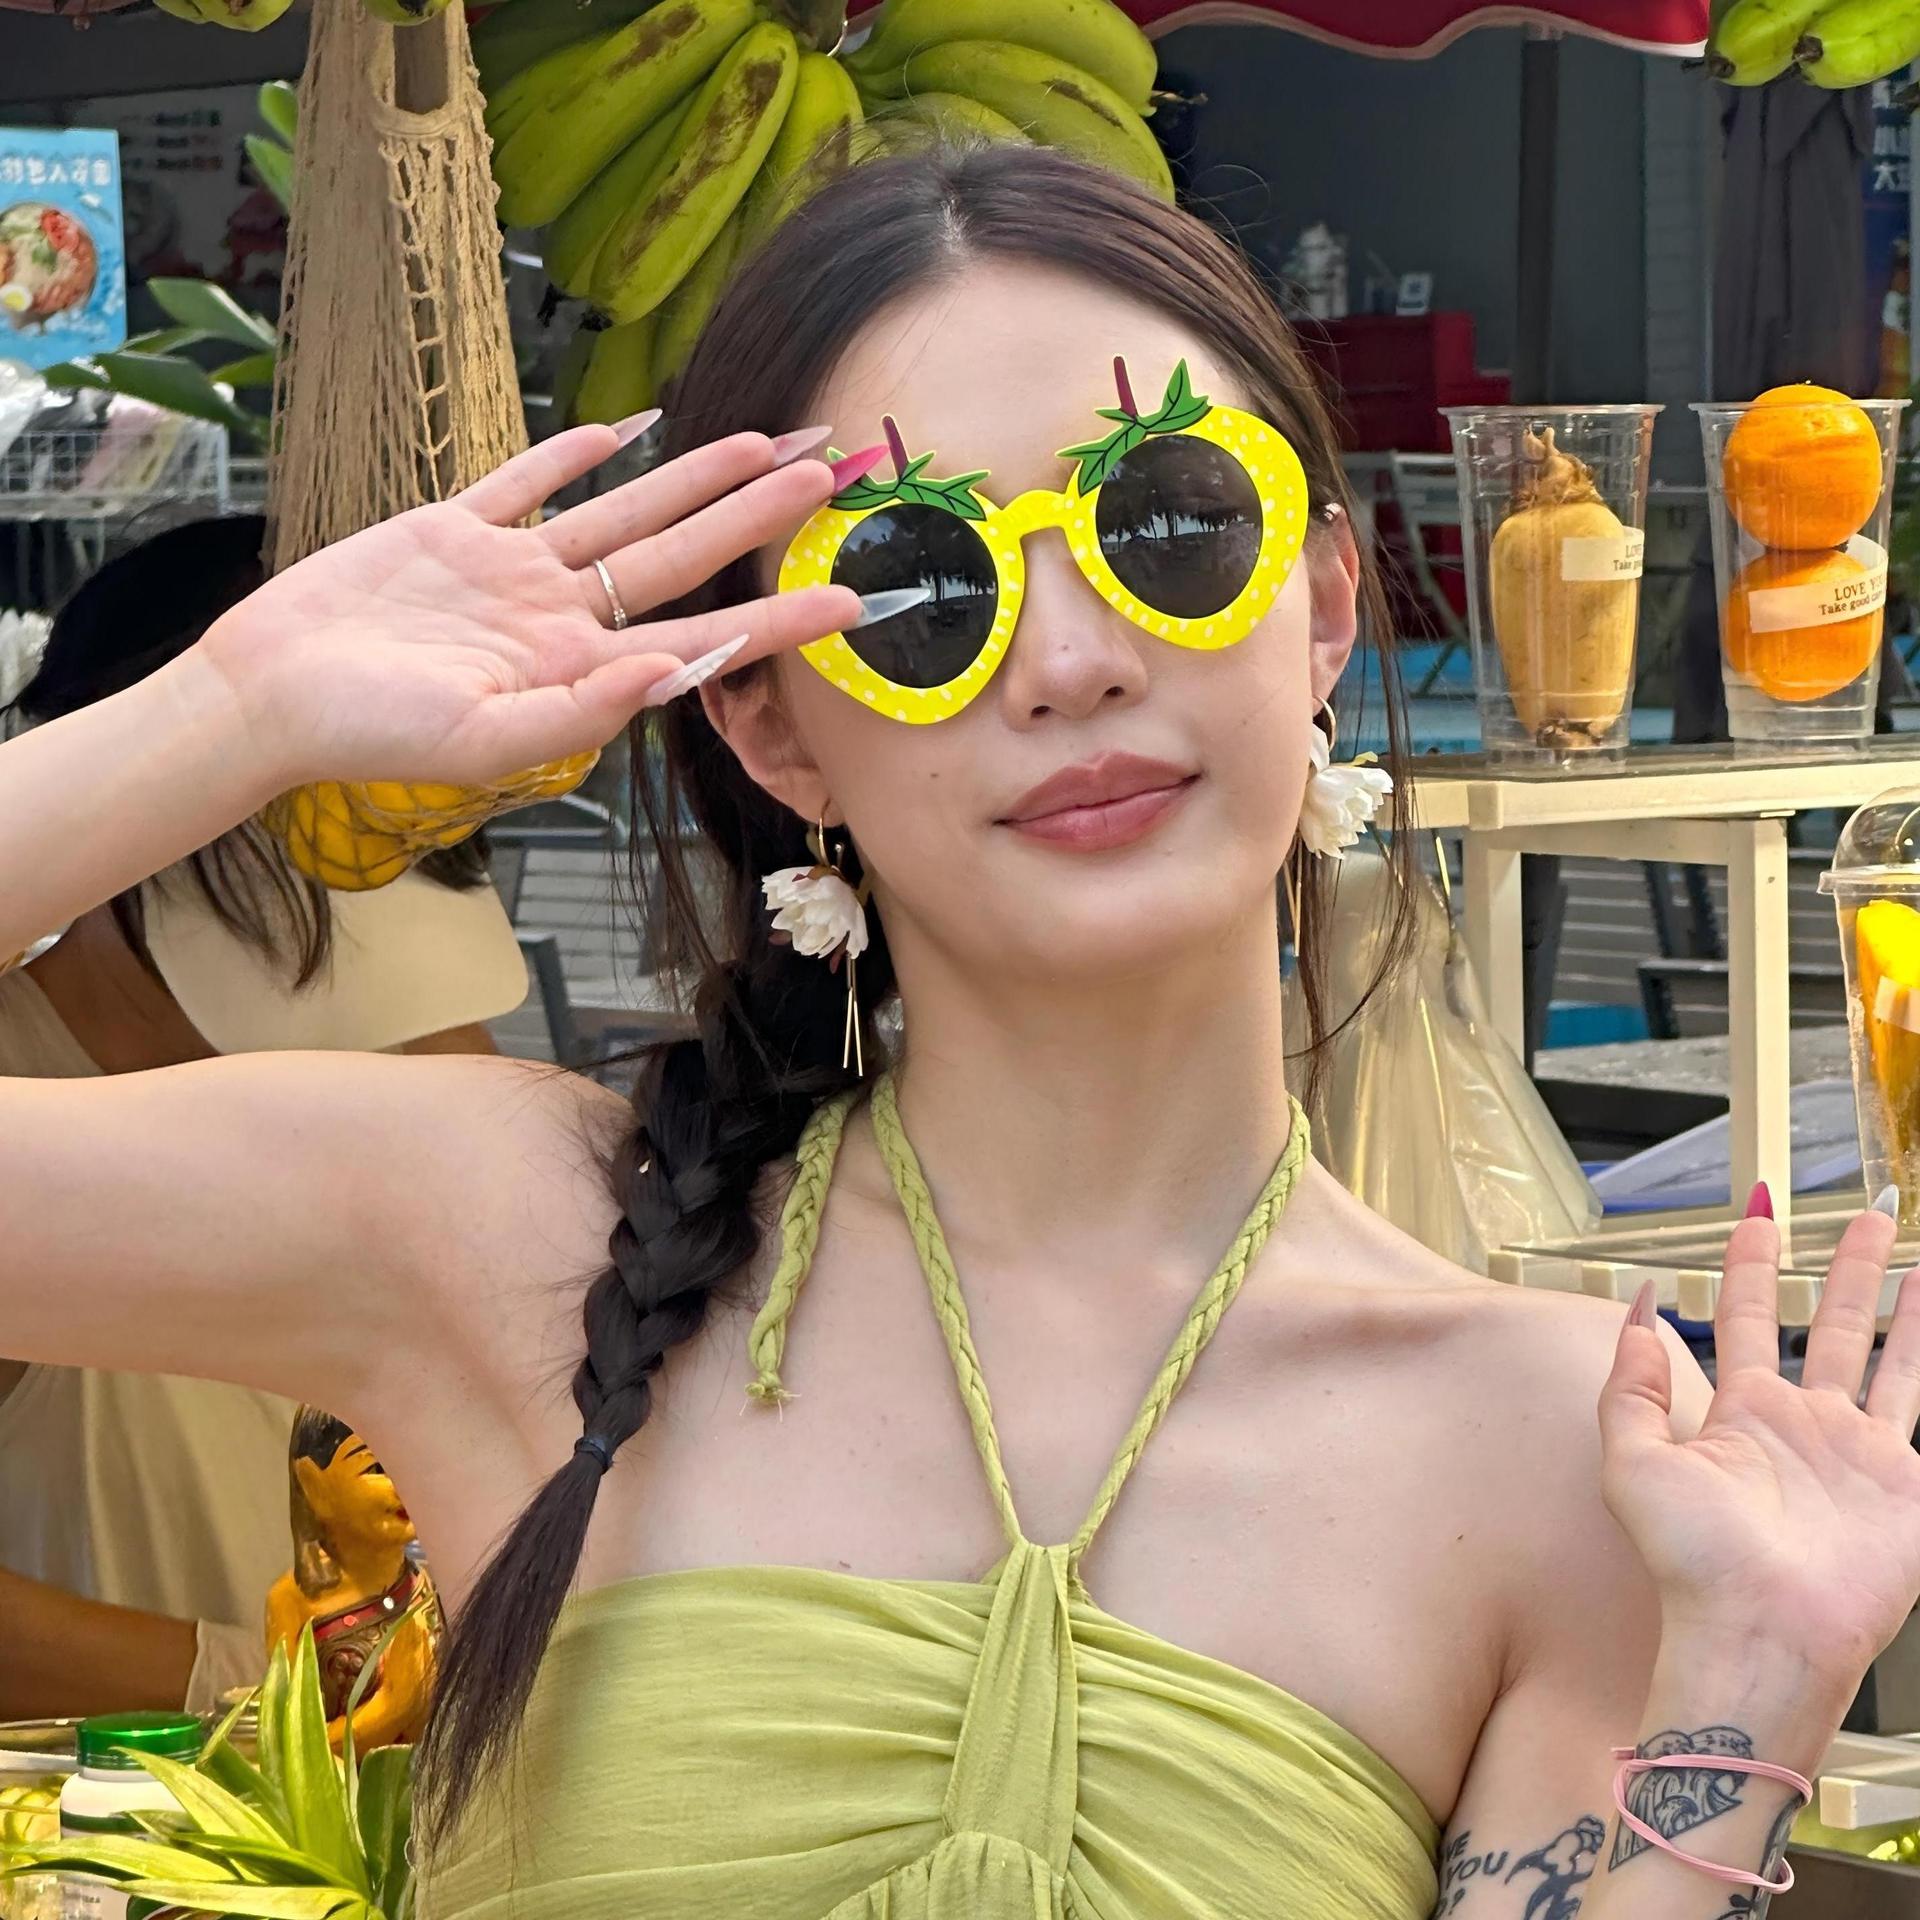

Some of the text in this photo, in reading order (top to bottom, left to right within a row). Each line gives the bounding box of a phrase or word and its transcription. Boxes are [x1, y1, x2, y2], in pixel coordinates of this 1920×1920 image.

[1834, 582, 1866, 601] LOVE
[1819, 602, 1848, 616] Take
[1850, 594, 1870, 611] good
[1446, 1851, 1508, 1890] YOU
